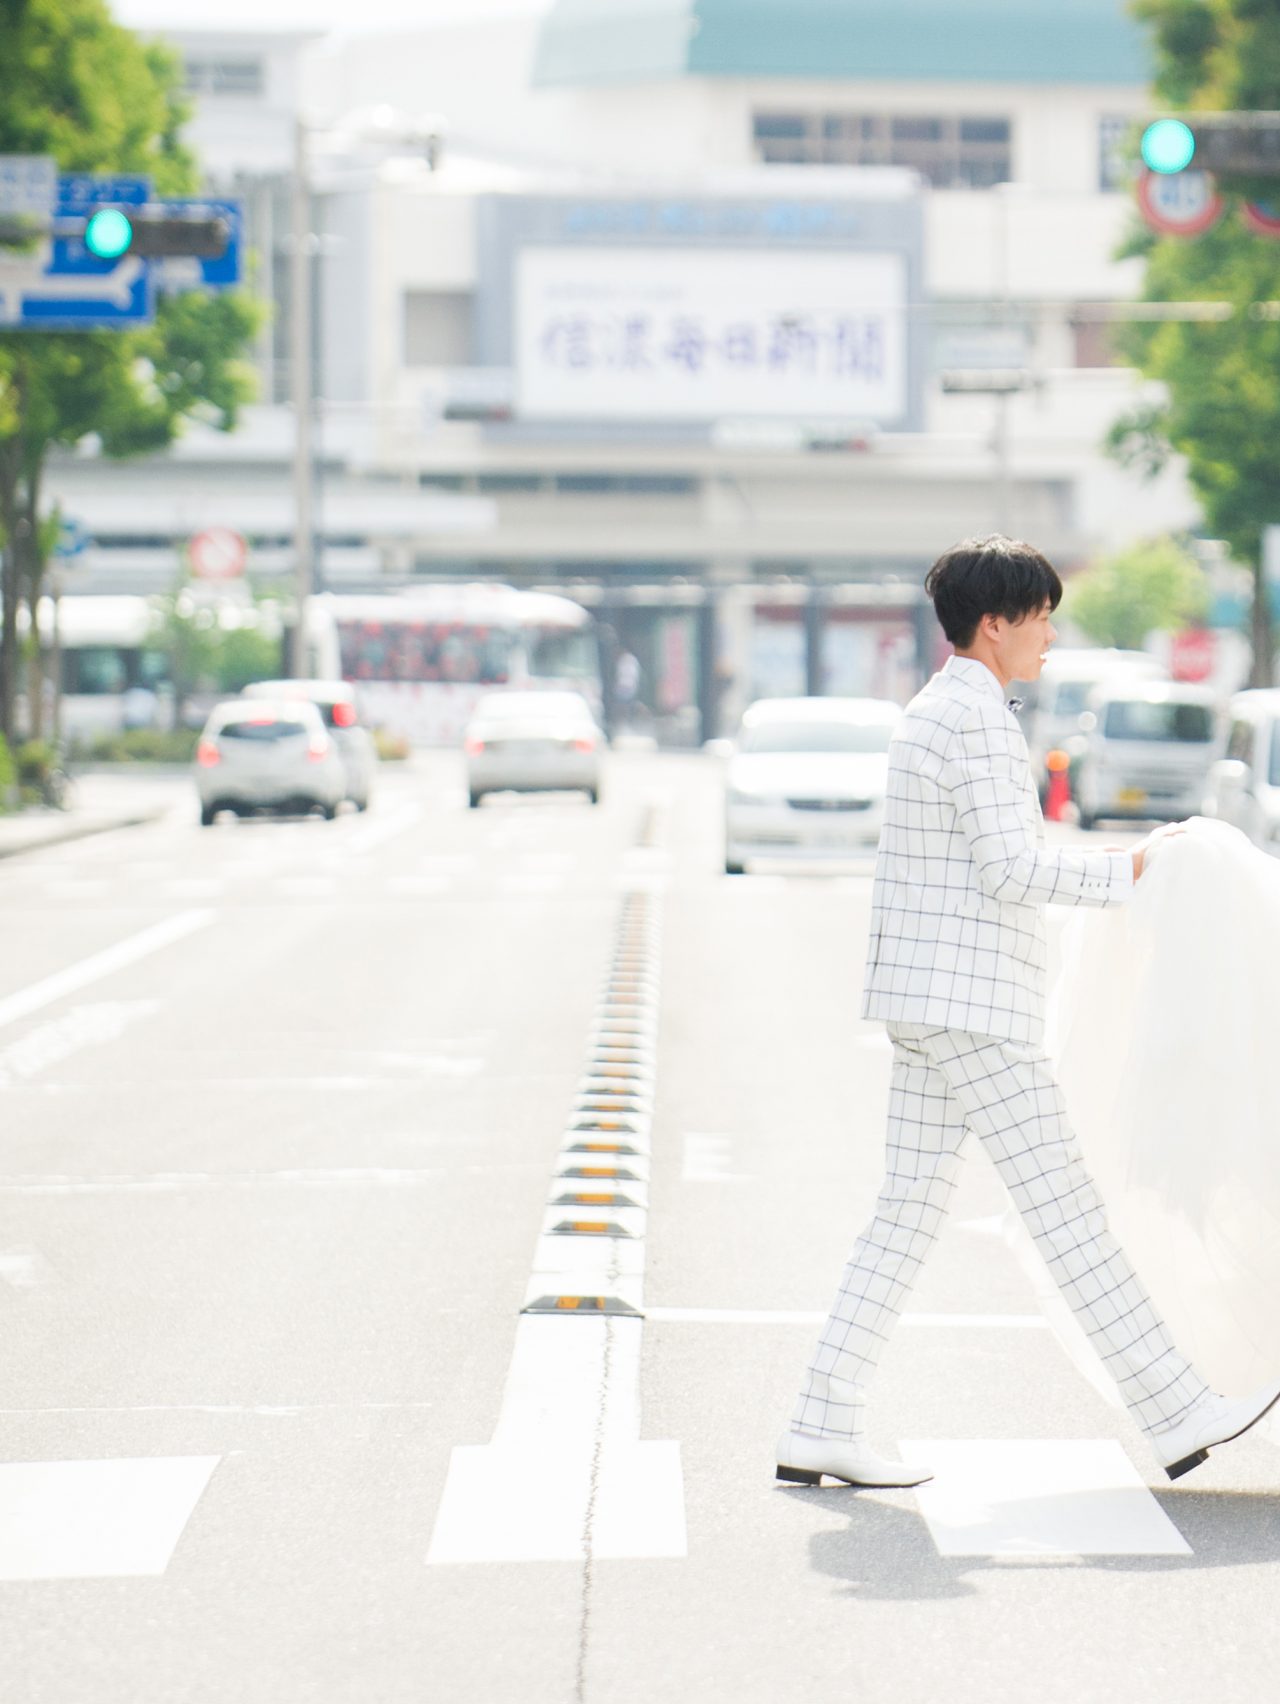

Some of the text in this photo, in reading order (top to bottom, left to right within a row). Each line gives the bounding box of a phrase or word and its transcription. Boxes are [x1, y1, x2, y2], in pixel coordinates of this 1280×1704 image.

[540, 309, 886, 384] 信濃毎日新聞
